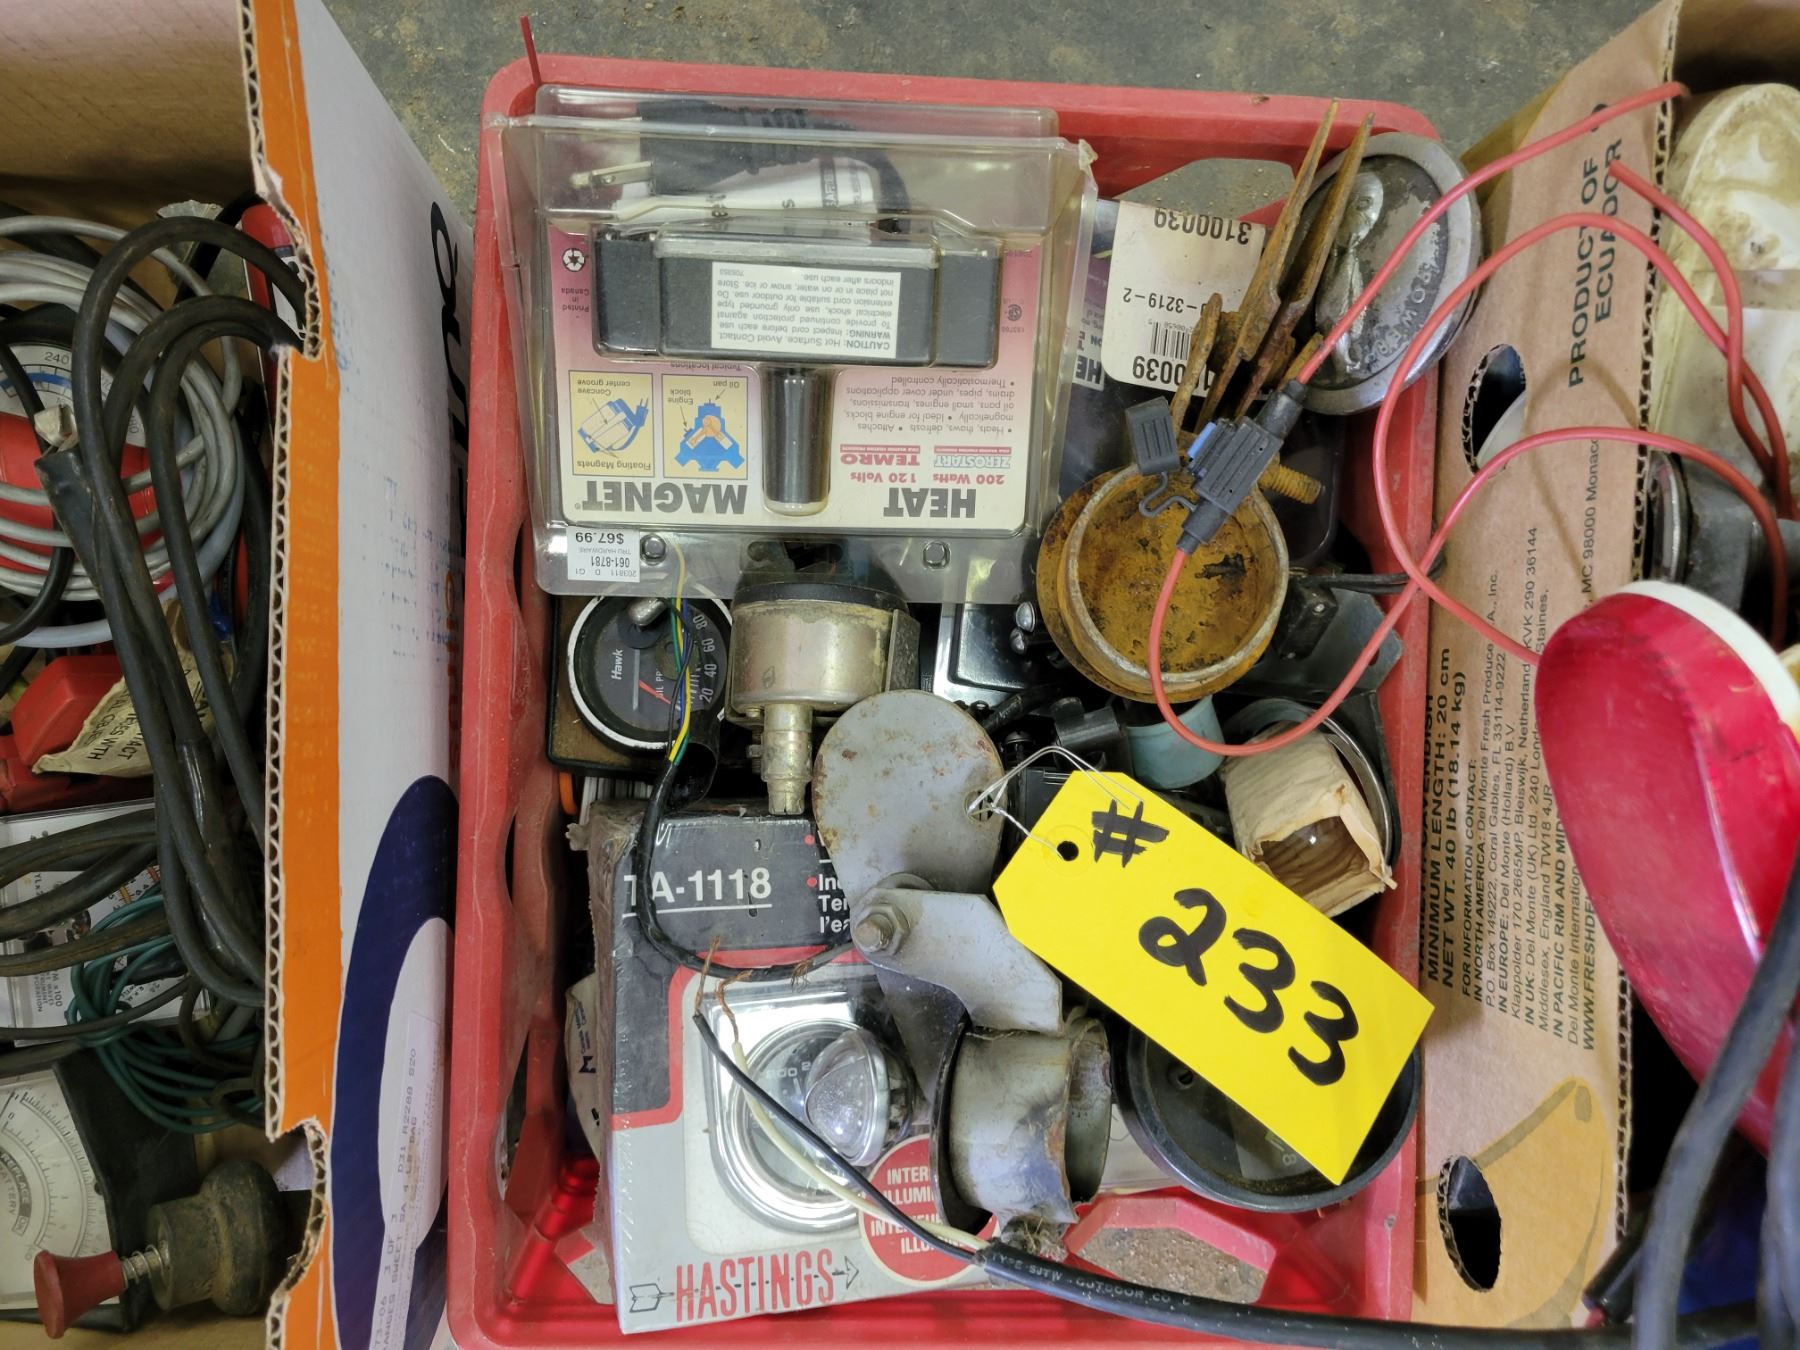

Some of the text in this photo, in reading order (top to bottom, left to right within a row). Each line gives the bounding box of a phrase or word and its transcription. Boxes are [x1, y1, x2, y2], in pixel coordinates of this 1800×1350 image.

[1580, 157, 1598, 204] OF
[1154, 209, 1251, 245] 3100039
[864, 278, 894, 286] indoors
[562, 288, 590, 296] Canada
[740, 302, 892, 317] electrical grounded
[854, 299, 893, 307] extension
[717, 311, 876, 327] provide continued protection against
[758, 335, 782, 344] Avoid
[813, 327, 842, 336] Inspect
[846, 330, 891, 340] WARNING:
[825, 339, 840, 347] Hot
[844, 340, 890, 350] CAUTION:
[44, 352, 70, 365] 240
[577, 378, 630, 388] center groove
[713, 379, 728, 387] pan
[892, 376, 1006, 388] Thermostatically controlled
[578, 388, 611, 396] Concave
[668, 397, 693, 405] Engine
[846, 387, 899, 397] applications
[929, 390, 953, 398] under
[876, 410, 905, 420] engine
[953, 402, 974, 410] small
[909, 413, 919, 422] for
[923, 413, 944, 422] Ideal
[959, 412, 1013, 422] magnetically
[858, 424, 942, 434] defrosts Attaches
[577, 460, 651, 470] Floating Magnets
[840, 454, 920, 466] TEMRO
[934, 456, 1011, 469] ZEROSTART
[850, 472, 1004, 485] 200 Watts 120 Volts
[582, 481, 976, 518] HEAT MAGNET
[576, 532, 624, 544] $67.99
[1583, 507, 1596, 559] 98000
[1526, 527, 1537, 575] 36144
[591, 556, 630, 567] 061-8781
[611, 568, 637, 577] 203811
[1582, 565, 1593, 593] MC
[1524, 581, 1534, 610] 290
[692, 614, 708, 630] 80
[702, 638, 715, 653] 60
[611, 648, 623, 680] Hawk
[704, 663, 717, 678] 40
[699, 687, 714, 703] 20
[1519, 663, 1530, 748] Netherland
[1474, 570, 1498, 1002] IN NORTH AMERICA: Del Monte Fresh Produce Inc.
[1515, 754, 1528, 825] Bleiswijk,
[1529, 775, 1539, 804] 240
[1428, 648, 1449, 981] MINIMUM LENGTH: 20 cm
[1091, 799, 1170, 868] #
[1443, 672, 1466, 988] NET WT. 40 lb (18.14 kg)
[1486, 653, 1506, 1007] P.O. Box 149222, Coral Gables, FL 33114-9222
[1528, 811, 1538, 838] Ltd.
[1541, 822, 1551, 866] TW18
[1499, 722, 1515, 1013] IN EUROPE: Del Monte (Holland) B.V.
[1513, 831, 1524, 898] 2665MP,
[1527, 844, 1538, 880] (UK)
[1462, 759, 1476, 996] FOR INFORMATION CONTACT:
[1513, 902, 1522, 929] 170
[1526, 885, 1536, 934] Monte
[1540, 874, 1553, 940] England
[1569, 864, 1580, 954] Internation
[1526, 940, 1535, 966] Del
[1554, 860, 1566, 1038] IN PACIFIC RIM AND
[1511, 936, 1523, 1019] Klappolder
[1583, 896, 1596, 1050] WWW.FRESHDE
[1138, 888, 1359, 1087] 233
[1526, 971, 1535, 1002] UK:
[1539, 947, 1551, 1031] Middlesex,
[1568, 960, 1579, 1012] Monte
[1525, 1007, 1535, 1025] IN
[1568, 1016, 1578, 1045] Del
[887, 1166, 930, 1185] INTER
[676, 1246, 834, 1322] HASTINGS
